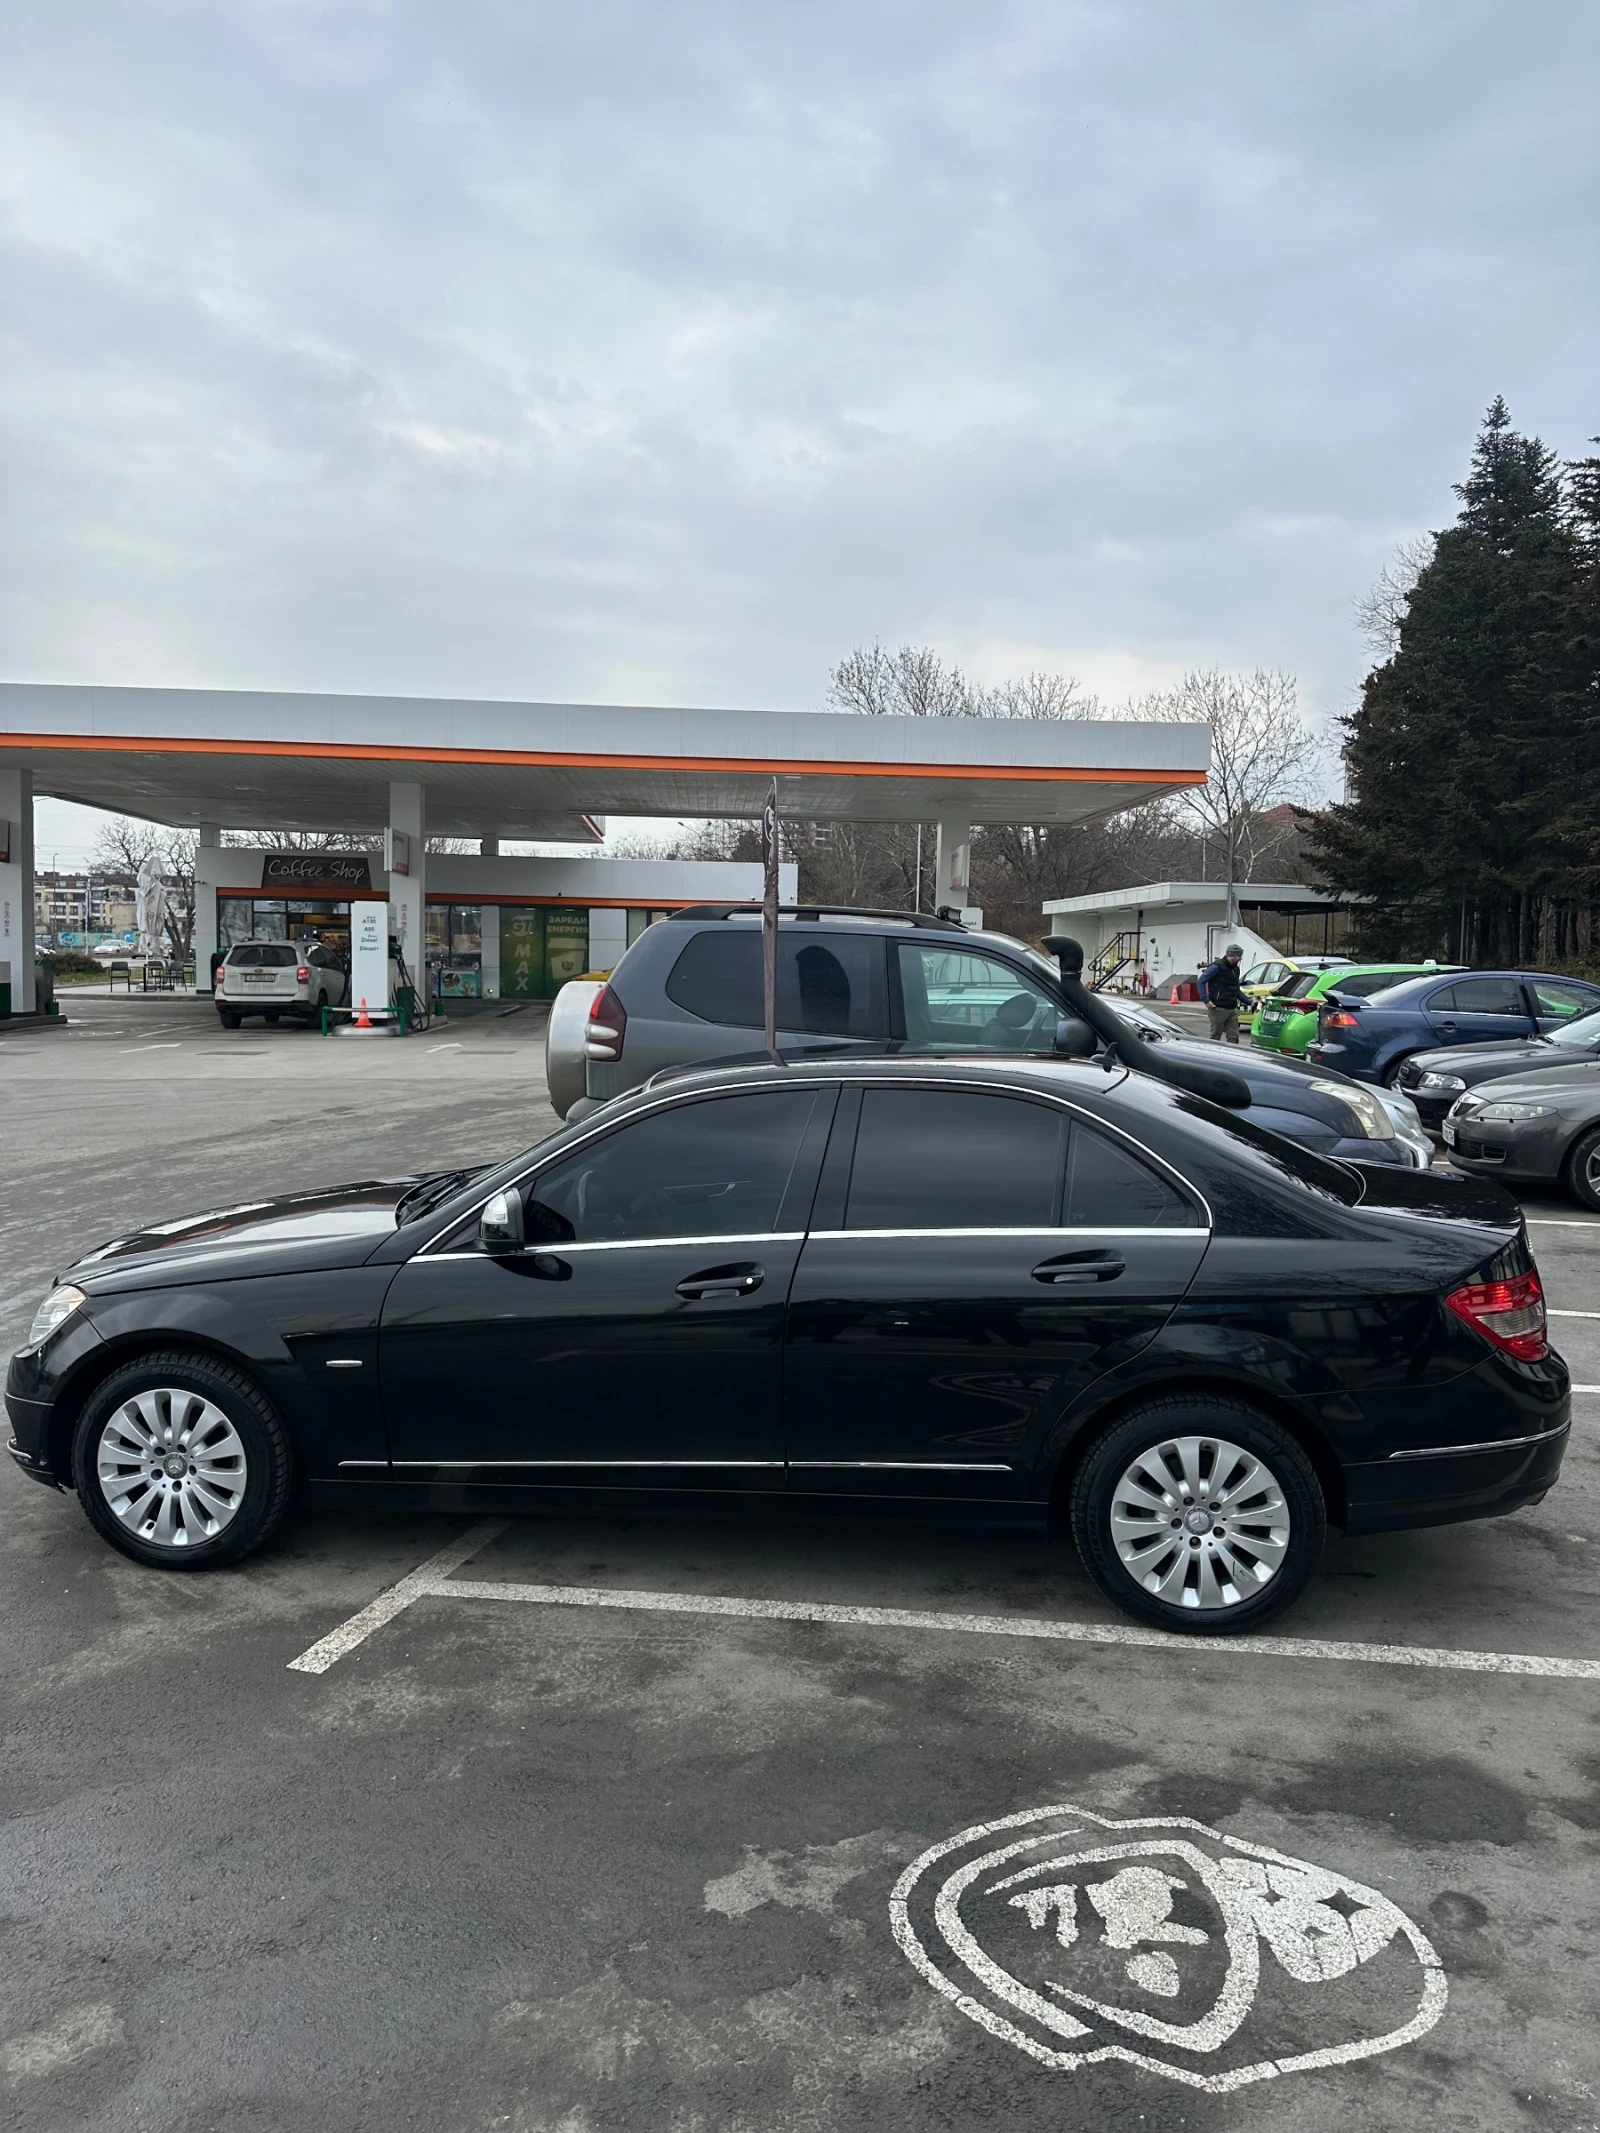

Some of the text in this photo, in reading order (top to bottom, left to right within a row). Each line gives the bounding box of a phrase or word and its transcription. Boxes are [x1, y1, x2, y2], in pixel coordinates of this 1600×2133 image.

[268, 859, 365, 884] Coffee Shop
[548, 916, 587, 925] ЗАРЕДИ
[547, 925, 589, 934] ЕНЕРГИЯ
